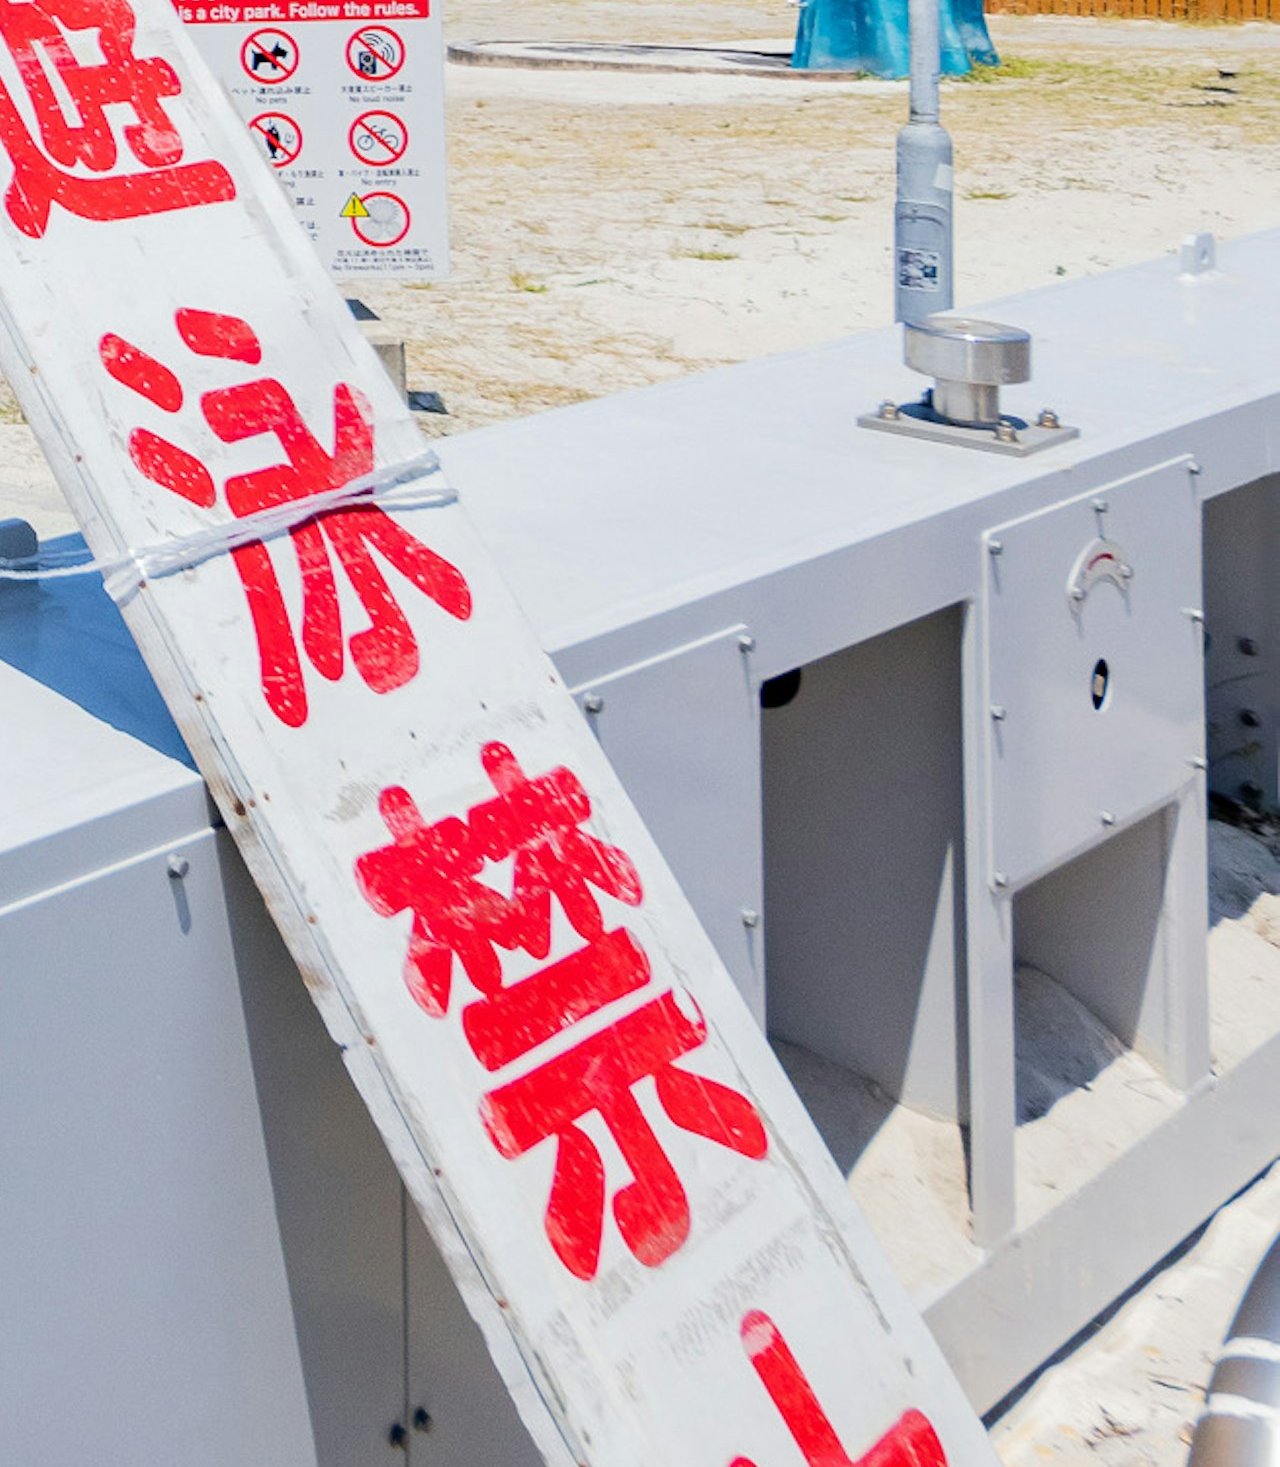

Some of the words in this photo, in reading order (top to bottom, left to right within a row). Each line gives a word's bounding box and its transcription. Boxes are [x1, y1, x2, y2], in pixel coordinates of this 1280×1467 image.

[196, 8, 206, 20] a
[210, 5, 239, 22] city
[244, 4, 286, 23] park.
[291, 3, 340, 18] Follow
[343, 2, 370, 17] the
[374, 1, 420, 16] rules.
[255, 96, 267, 104] No
[269, 96, 288, 105] pets
[361, 178, 373, 186] No
[375, 179, 397, 187] entry
